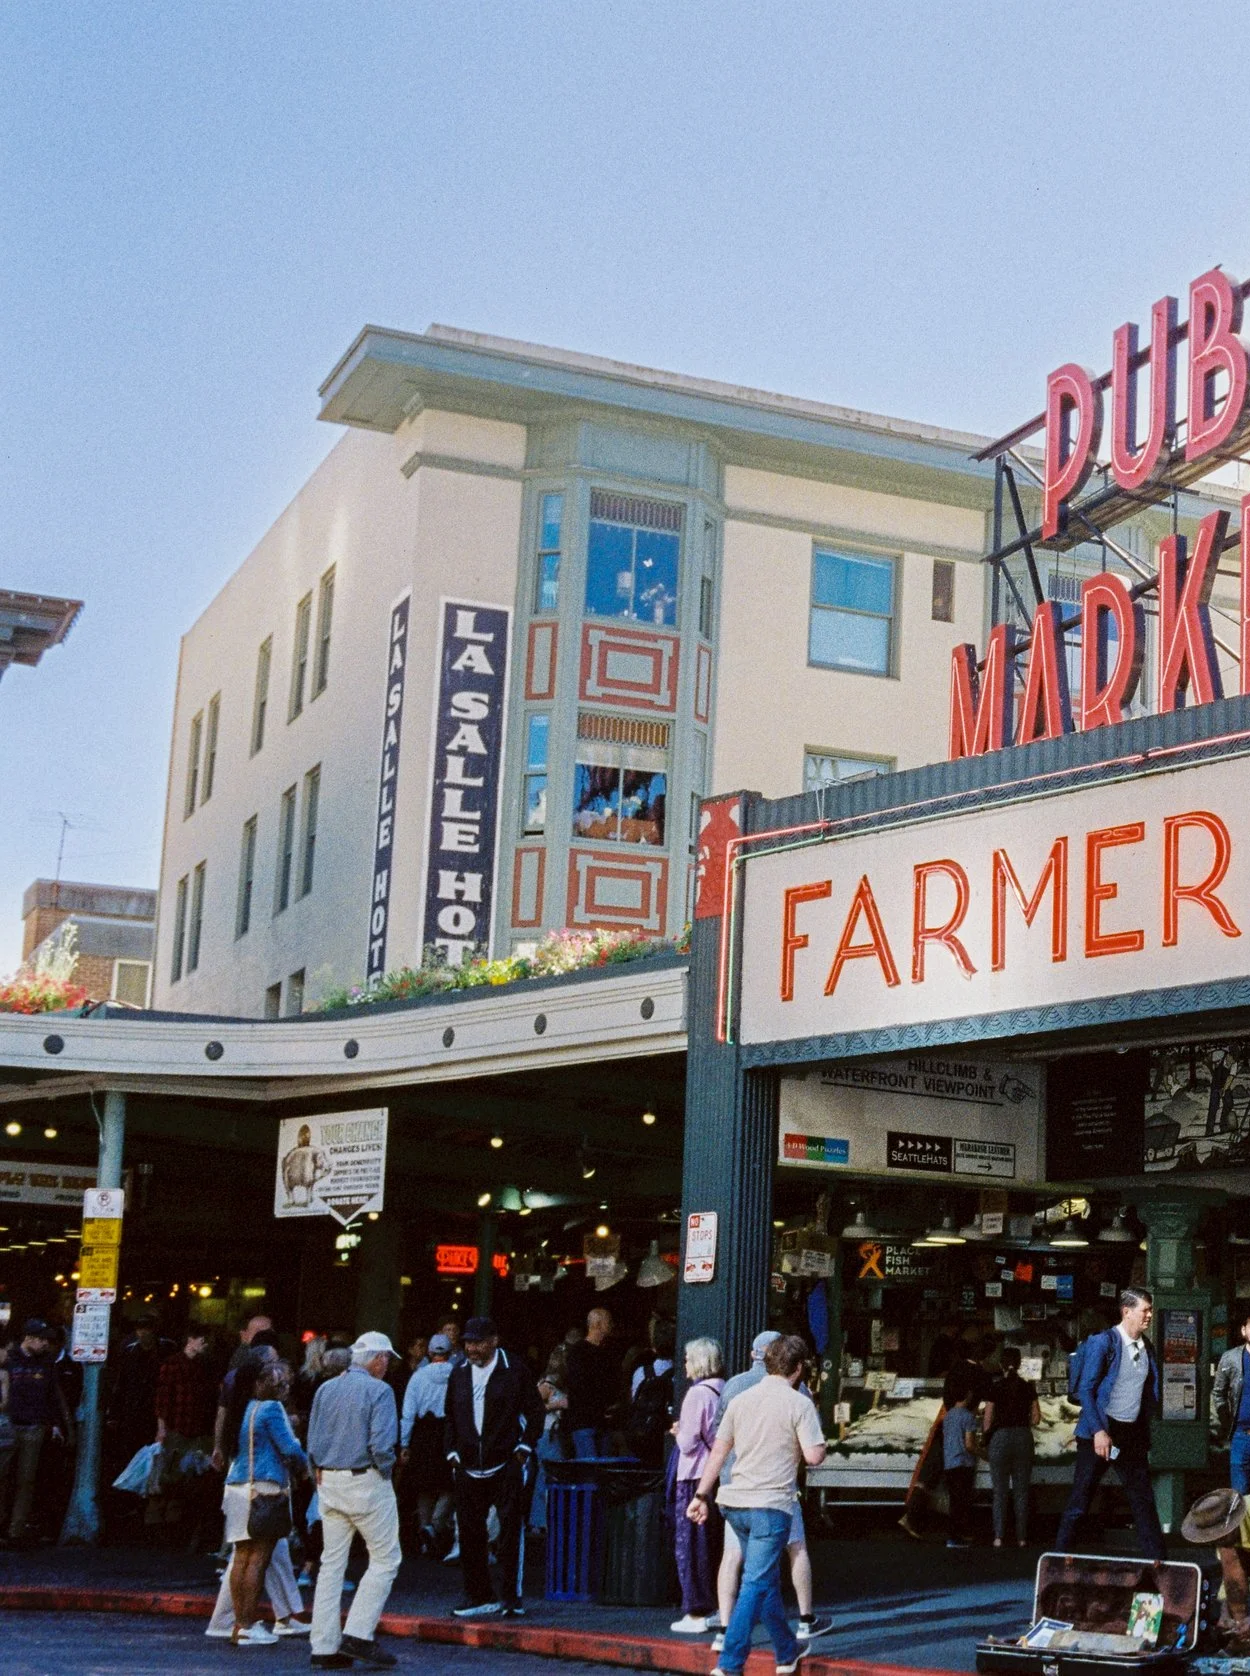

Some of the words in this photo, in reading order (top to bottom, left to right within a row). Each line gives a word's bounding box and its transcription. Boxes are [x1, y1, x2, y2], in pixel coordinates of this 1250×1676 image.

[390, 611, 405, 676] LA
[451, 609, 494, 676] LA
[377, 683, 403, 850] SALLE
[440, 691, 490, 854] SALLE
[435, 869, 483, 967] HOT
[821, 1066, 917, 1089] WATERFRONT
[923, 1077, 996, 1098] VIEWPOINT
[908, 1059, 978, 1080] HILLCLIMB
[984, 1068, 993, 1081] &
[691, 1229, 713, 1241] STOPS
[885, 1256, 910, 1265] FISH
[885, 1266, 930, 1276] MARKET
